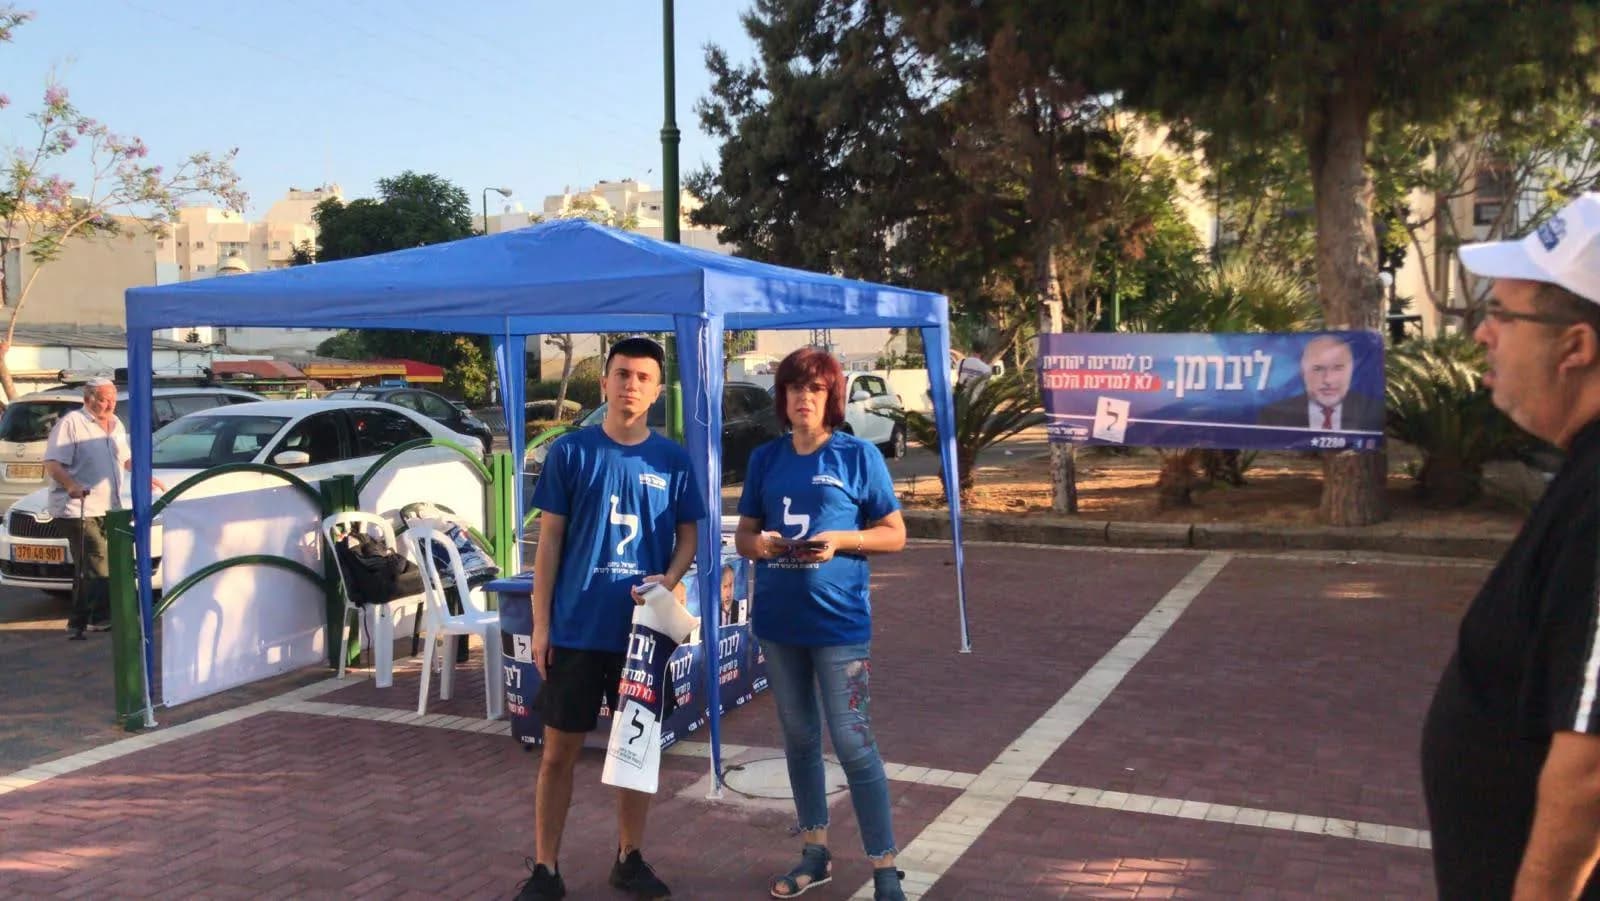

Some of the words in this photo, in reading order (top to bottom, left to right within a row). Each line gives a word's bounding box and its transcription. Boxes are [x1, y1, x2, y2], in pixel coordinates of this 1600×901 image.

[1042, 354, 1085, 370] יהודית
[1087, 353, 1136, 370] למדינה
[1139, 355, 1153, 373] כן
[1083, 372, 1131, 389] למדינת
[1135, 373, 1153, 390] לא
[1167, 350, 1273, 398] ליברמן.
[1106, 401, 1119, 432] ל
[610, 494, 638, 556] ל
[628, 708, 645, 745] ל
